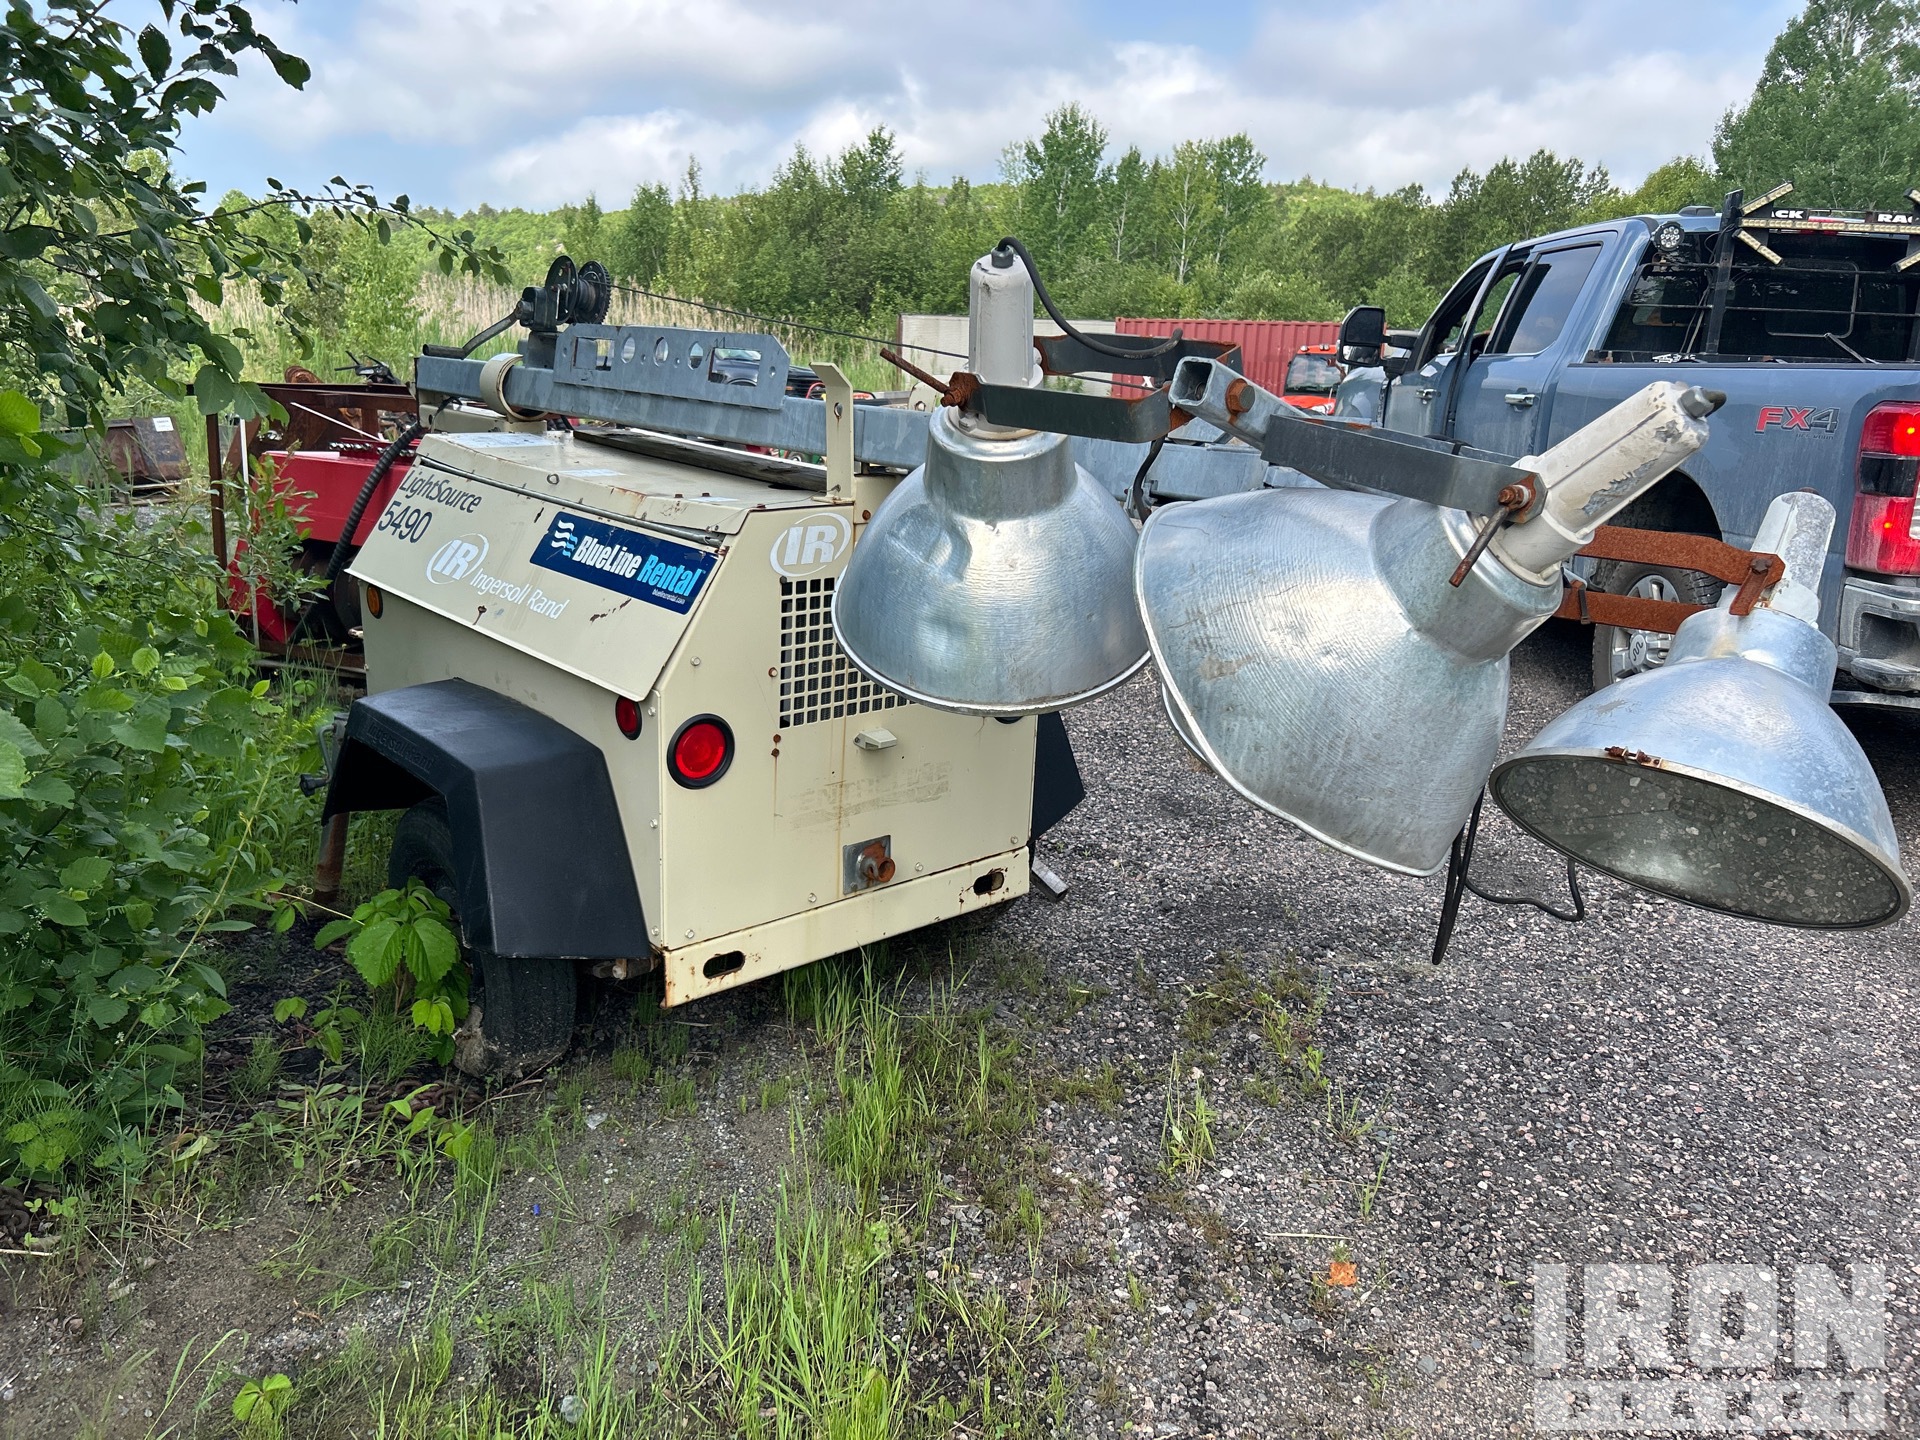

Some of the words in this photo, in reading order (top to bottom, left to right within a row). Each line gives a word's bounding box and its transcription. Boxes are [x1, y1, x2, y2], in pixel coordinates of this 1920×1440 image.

[1771, 209, 1804, 219] CK
[1755, 406, 1840, 434] FX4
[399, 470, 482, 513] LightSource
[378, 500, 432, 543] 5490
[433, 539, 479, 580] IR
[572, 535, 642, 579] BlueLine
[637, 554, 702, 596] Rental
[783, 525, 837, 565] IR
[470, 568, 530, 604] Ingersoll
[527, 590, 570, 620] Rand
